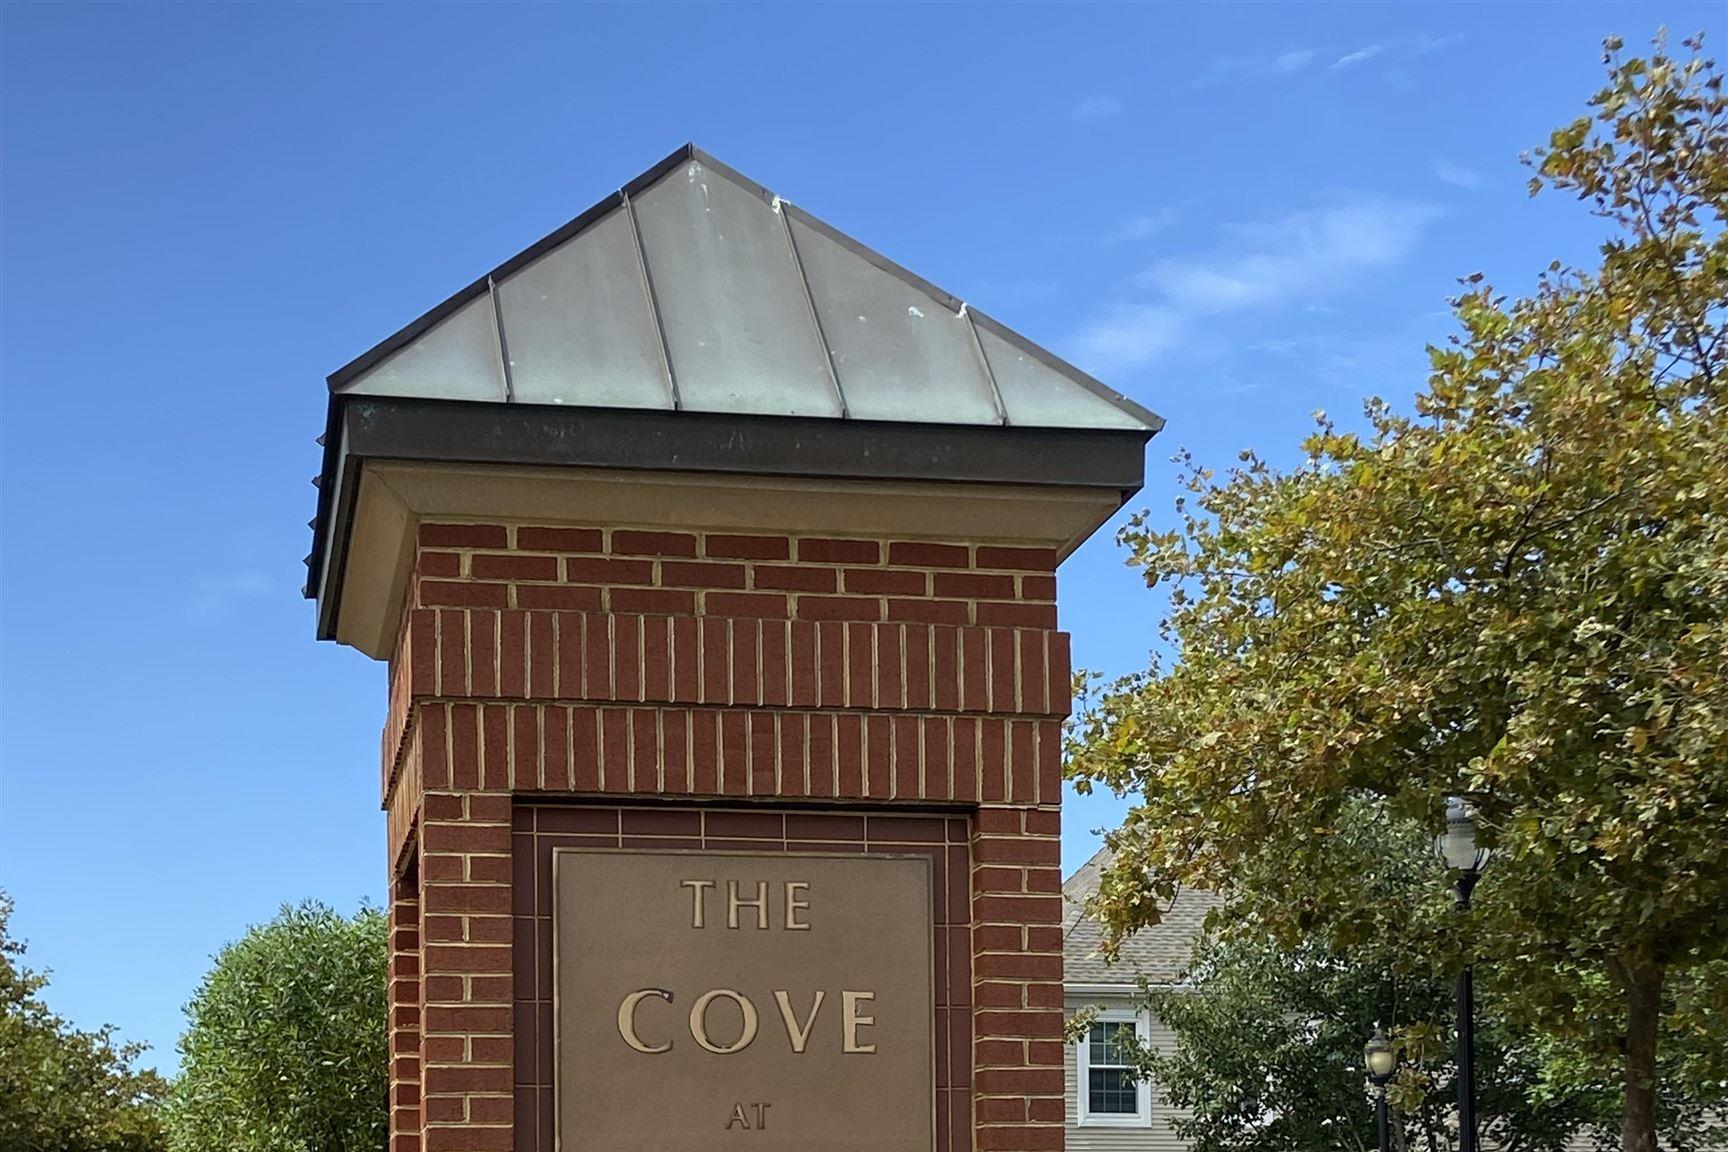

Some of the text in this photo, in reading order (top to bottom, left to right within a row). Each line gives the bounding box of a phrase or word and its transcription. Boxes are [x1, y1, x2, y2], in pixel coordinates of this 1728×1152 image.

[680, 879, 813, 932] THE
[616, 988, 878, 1055] COVE
[725, 1101, 772, 1131] AT
